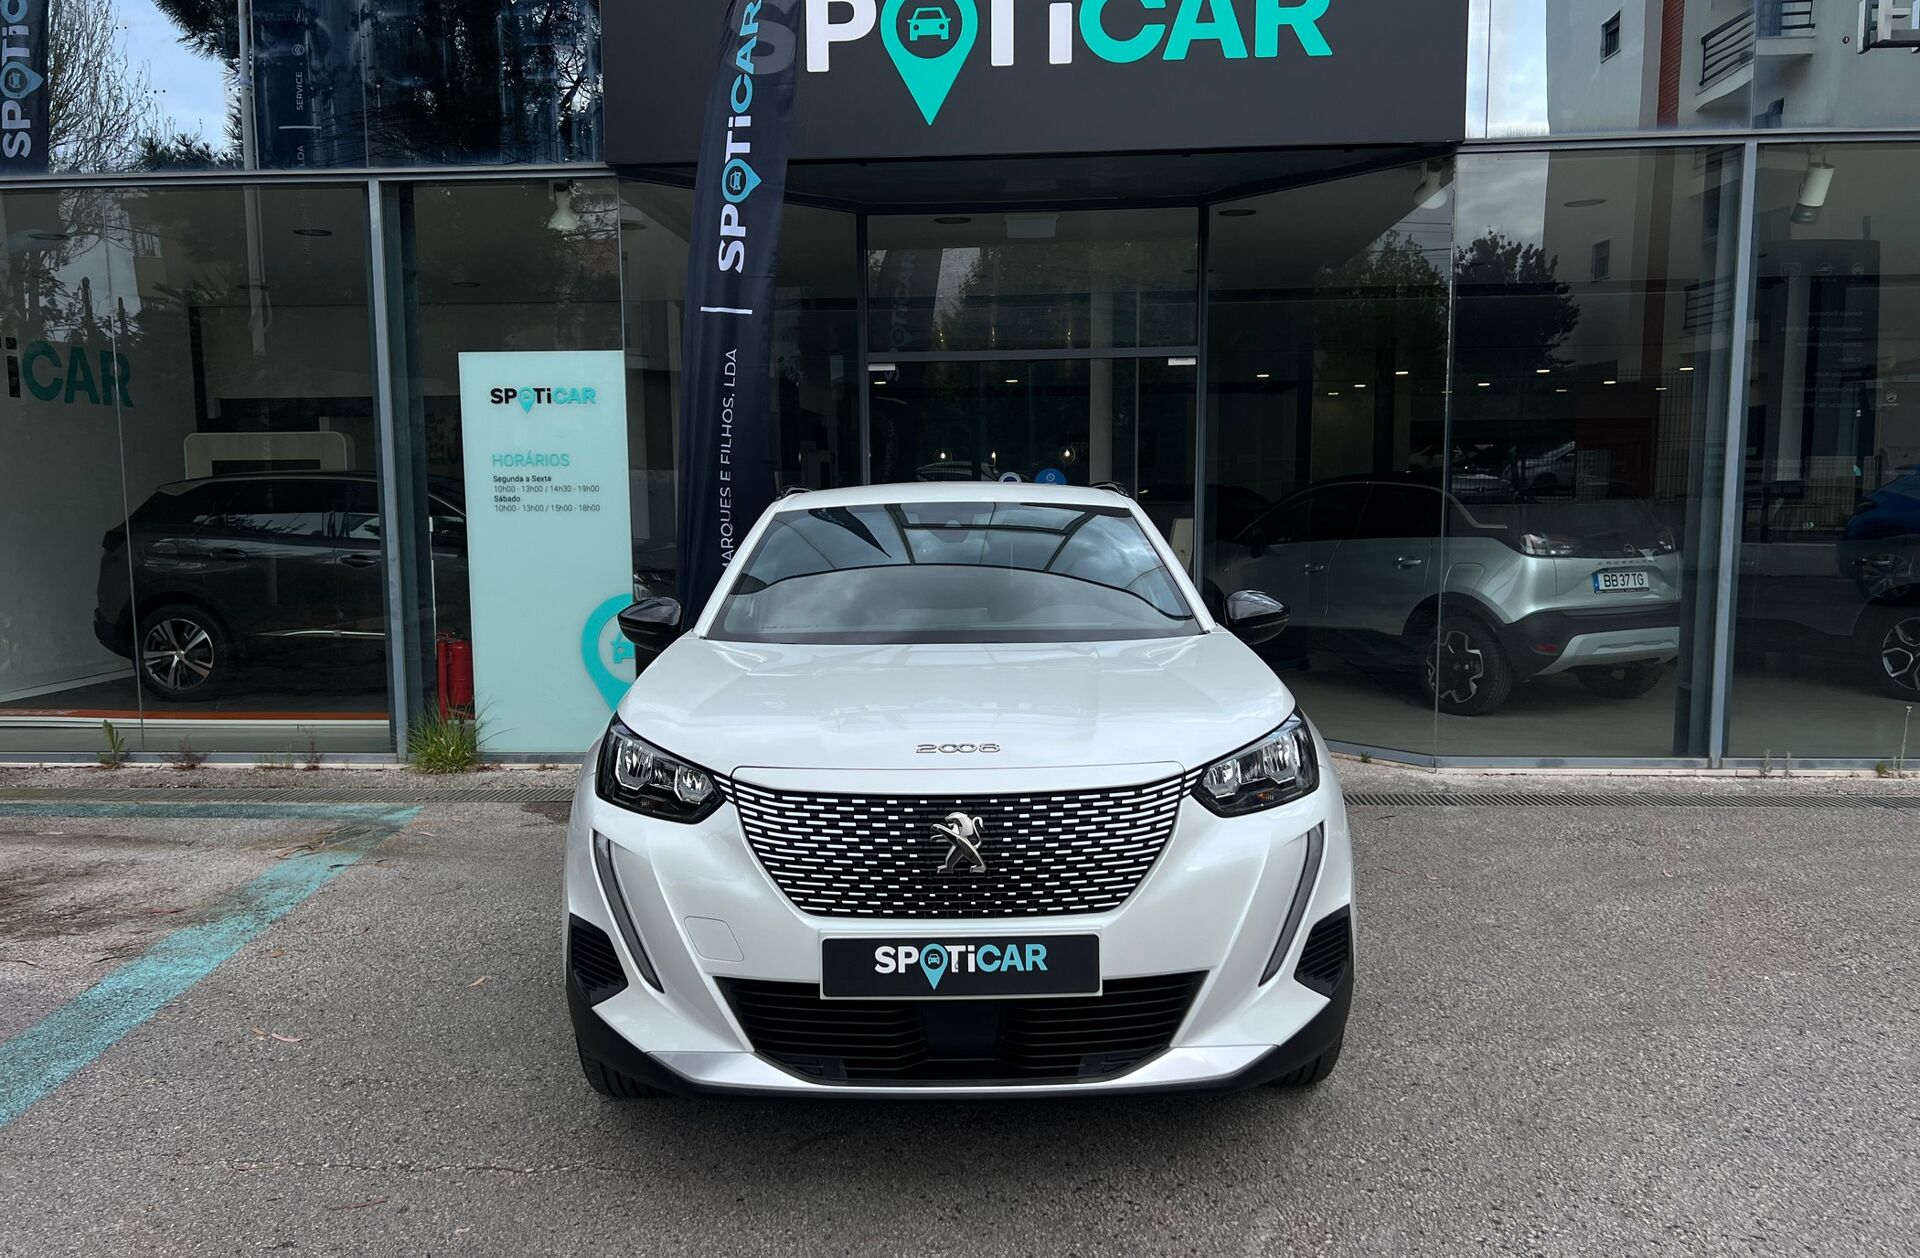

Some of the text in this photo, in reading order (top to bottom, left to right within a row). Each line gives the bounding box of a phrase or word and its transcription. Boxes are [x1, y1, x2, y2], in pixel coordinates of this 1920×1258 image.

[295, 71, 304, 111] SERVICE
[723, 348, 737, 387] LDA
[491, 450, 570, 467] HORÁRIOS
[493, 475, 524, 484] Segunda
[720, 470, 731, 481] E
[494, 485, 516, 493] 10h00
[522, 485, 543, 493] 13h00
[550, 485, 572, 493] 14h30
[578, 485, 600, 493] 19h00
[494, 495, 521, 503] Sábado
[495, 504, 517, 512] 10h00
[522, 504, 544, 512] 13h00
[551, 504, 573, 512] 15h00
[579, 504, 601, 512] 18h00
[1603, 573, 1644, 587] BB 37 TG
[916, 743, 1001, 754] 2008
